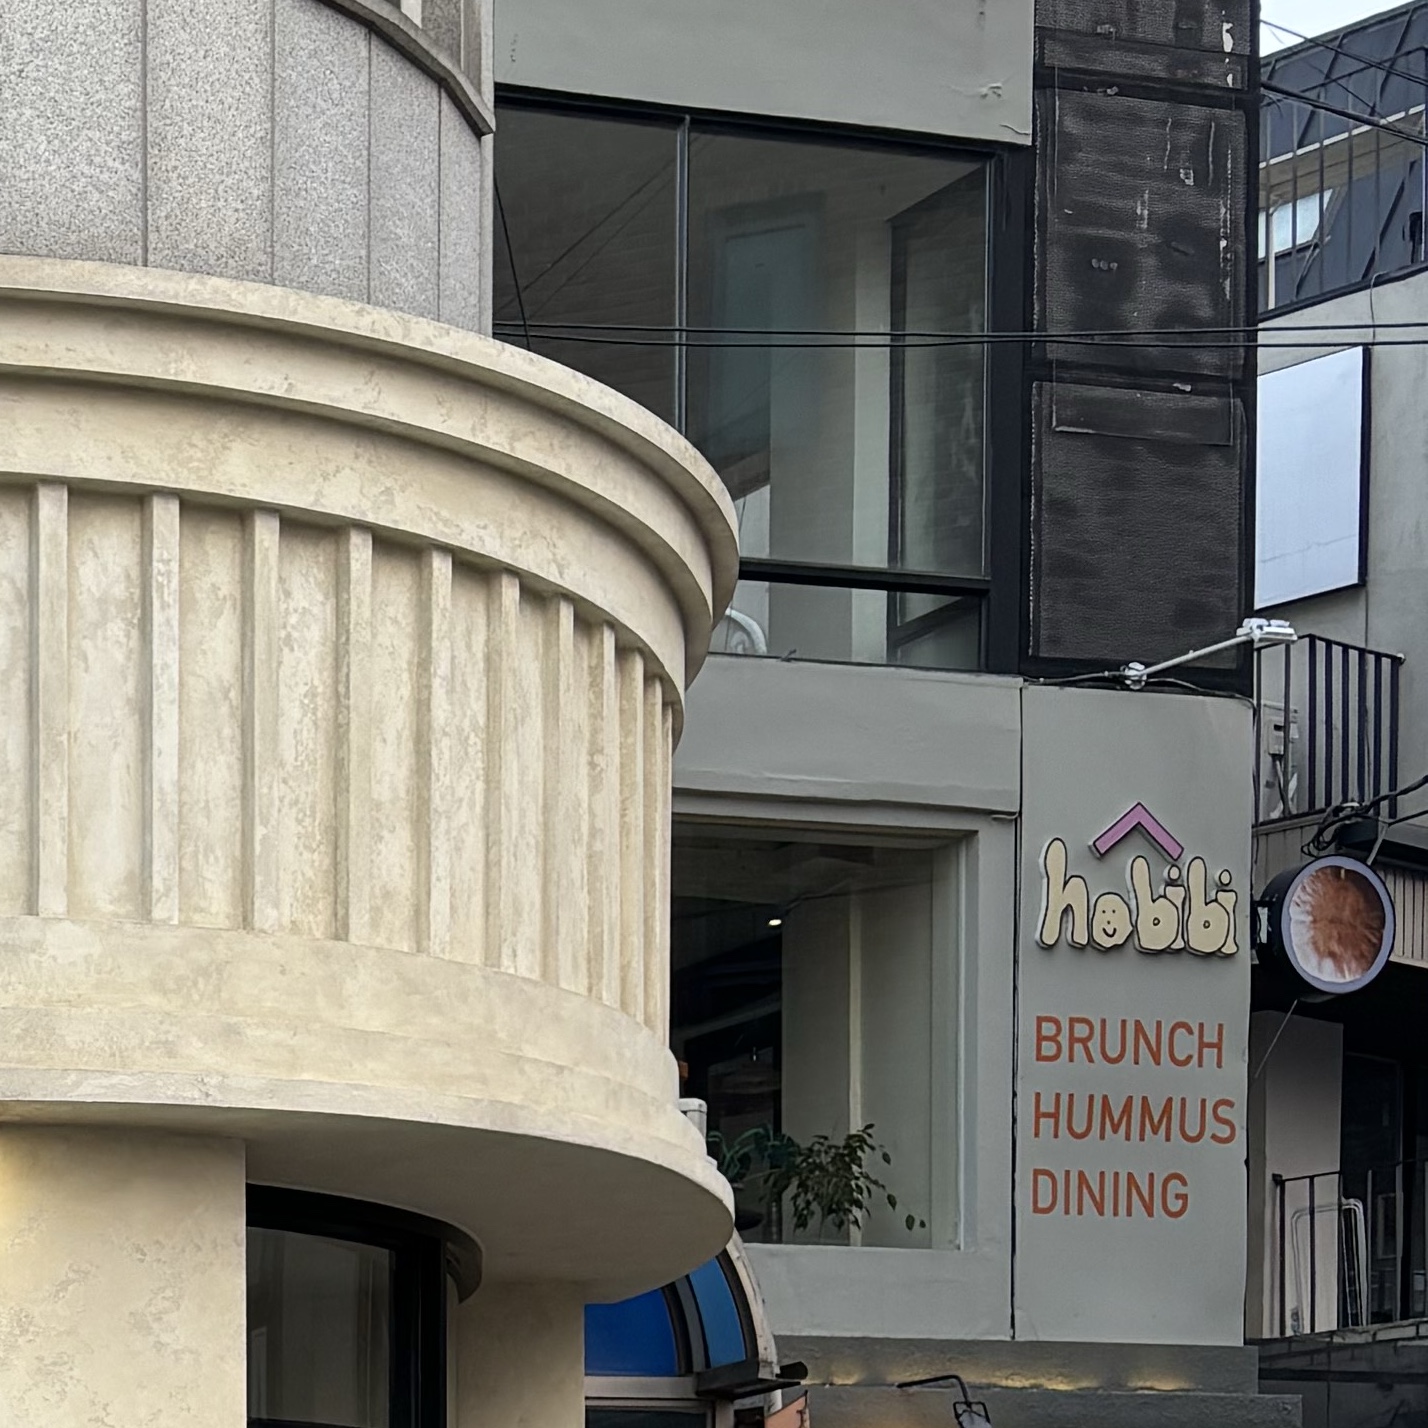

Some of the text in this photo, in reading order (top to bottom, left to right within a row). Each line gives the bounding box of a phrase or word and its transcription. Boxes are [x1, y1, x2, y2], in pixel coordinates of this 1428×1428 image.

[1034, 1015, 1225, 1069] BRUNCH
[1032, 1091, 1237, 1145] HUMMUS
[1031, 1168, 1190, 1219] DINING
